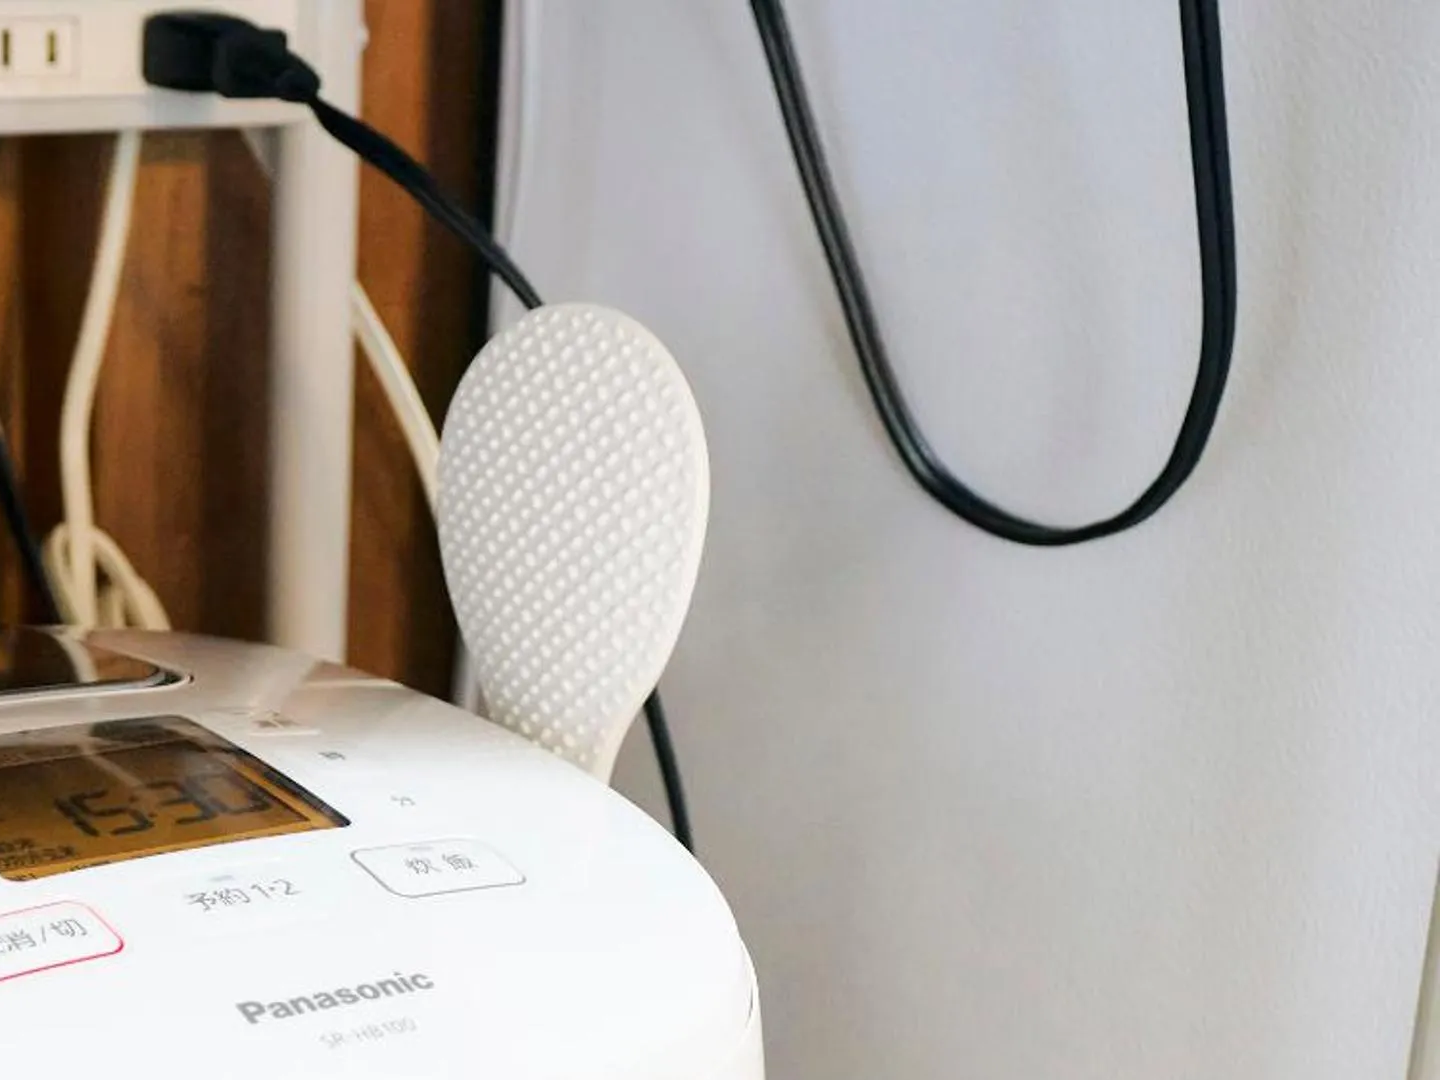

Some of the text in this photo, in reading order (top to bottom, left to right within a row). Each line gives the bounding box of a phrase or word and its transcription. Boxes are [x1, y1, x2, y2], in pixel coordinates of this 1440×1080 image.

[54, 768, 273, 836] 15:30
[405, 853, 479, 874] 炊飯
[236, 971, 435, 1025] Panasonic
